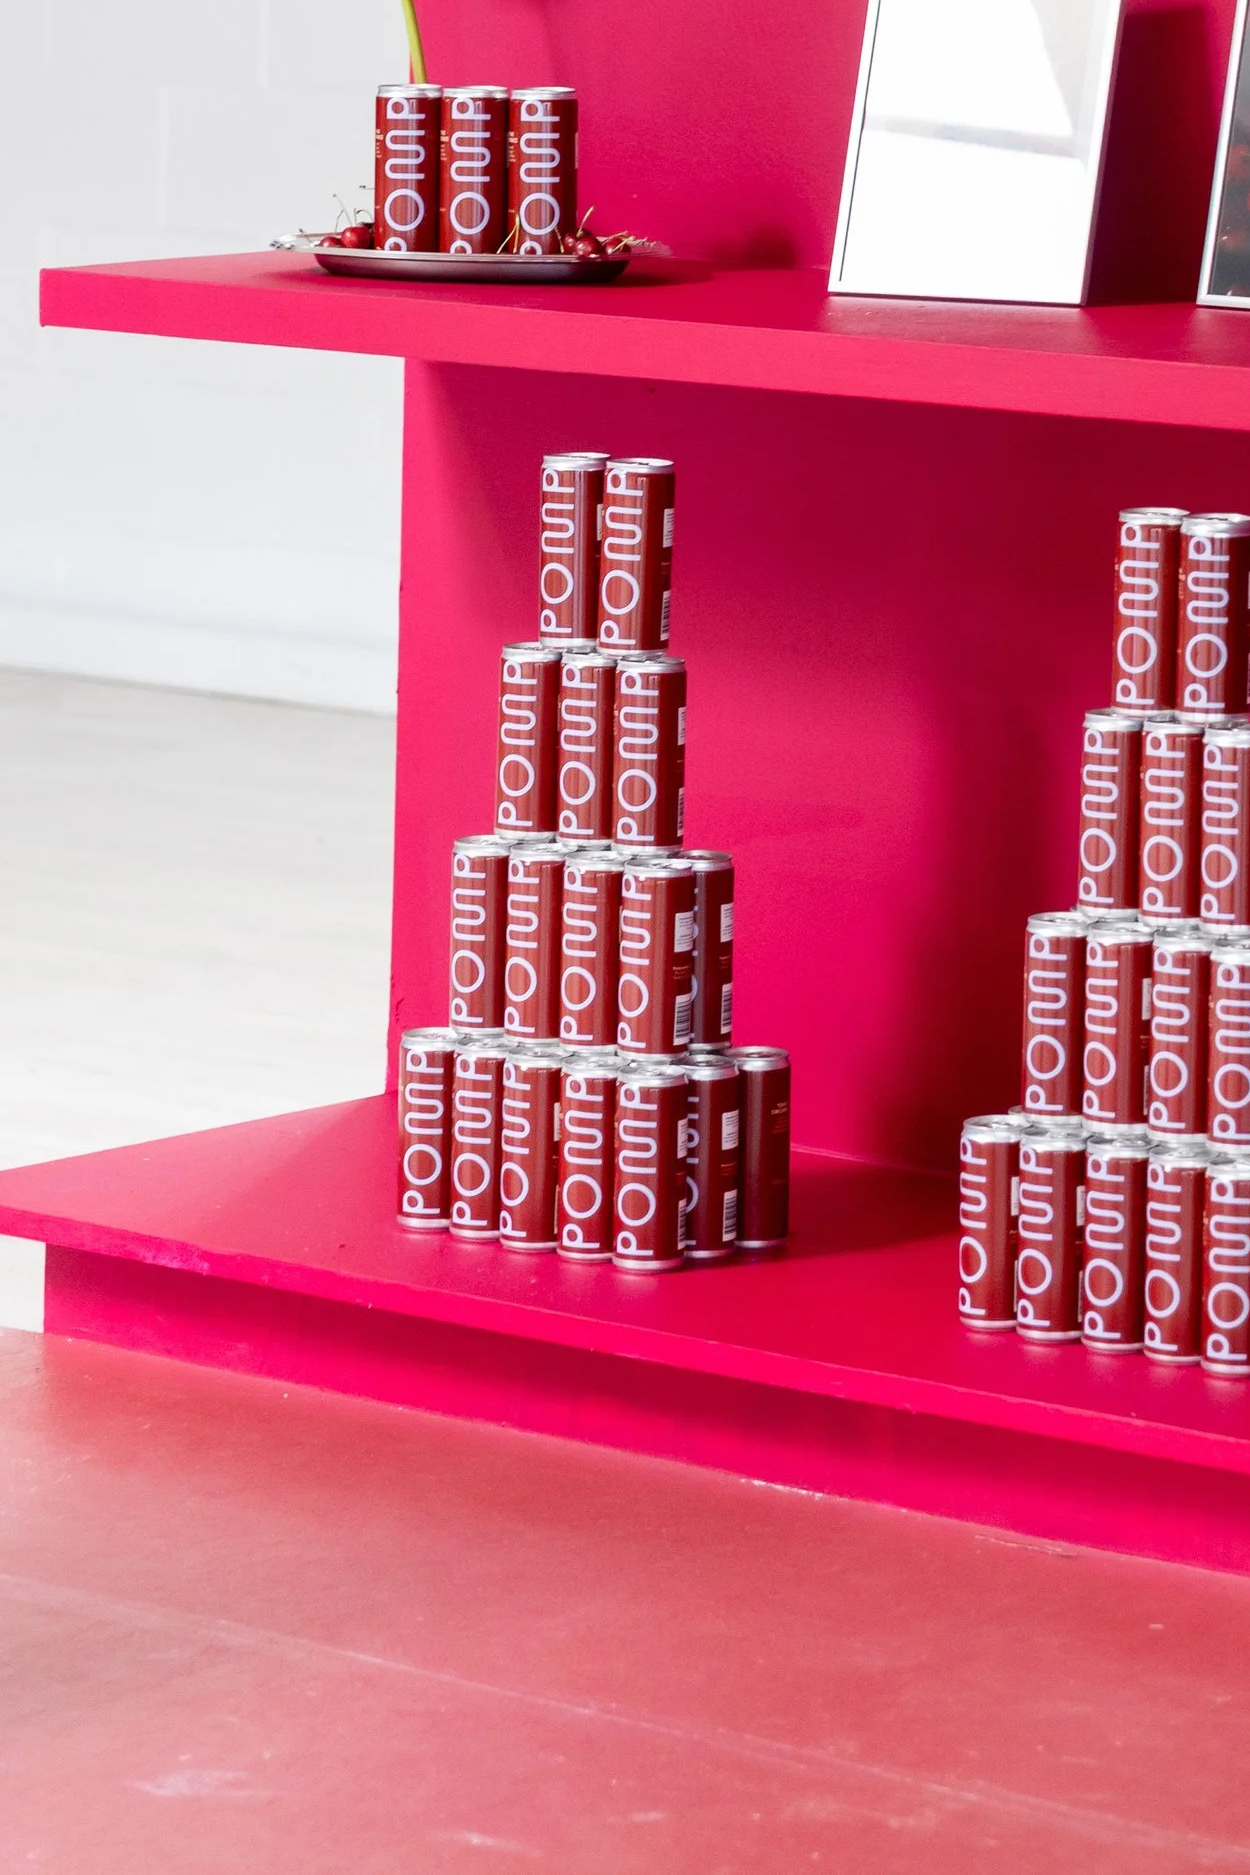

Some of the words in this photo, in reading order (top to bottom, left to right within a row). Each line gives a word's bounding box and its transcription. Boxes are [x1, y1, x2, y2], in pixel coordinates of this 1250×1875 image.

[540, 469, 575, 633] POMP
[600, 469, 643, 645] POMP
[1115, 522, 1160, 705] POMP
[1183, 535, 1230, 709] POMP
[498, 660, 538, 827] POMP
[559, 663, 597, 835] POMP
[617, 670, 659, 841] POMP
[1078, 728, 1120, 904] POMP
[1142, 730, 1186, 913] POMP
[1200, 743, 1240, 920] POMP
[451, 852, 486, 1023] POMP
[504, 858, 540, 1033] POMP
[560, 865, 598, 1042] POMP
[617, 873, 652, 1048] POMP
[1025, 932, 1068, 1111] POMP
[1082, 938, 1119, 1119] POMP
[1149, 945, 1191, 1130] POMP
[402, 1049, 444, 1214] POMP
[452, 1053, 492, 1227] POMP
[499, 1059, 531, 1237] POMP
[562, 1073, 604, 1249] POMP
[615, 1083, 658, 1256] POMP
[958, 1137, 987, 1316] POMP
[1016, 1144, 1054, 1327] POMP
[1083, 1152, 1125, 1340] POMP
[1144, 1160, 1181, 1352] POMP
